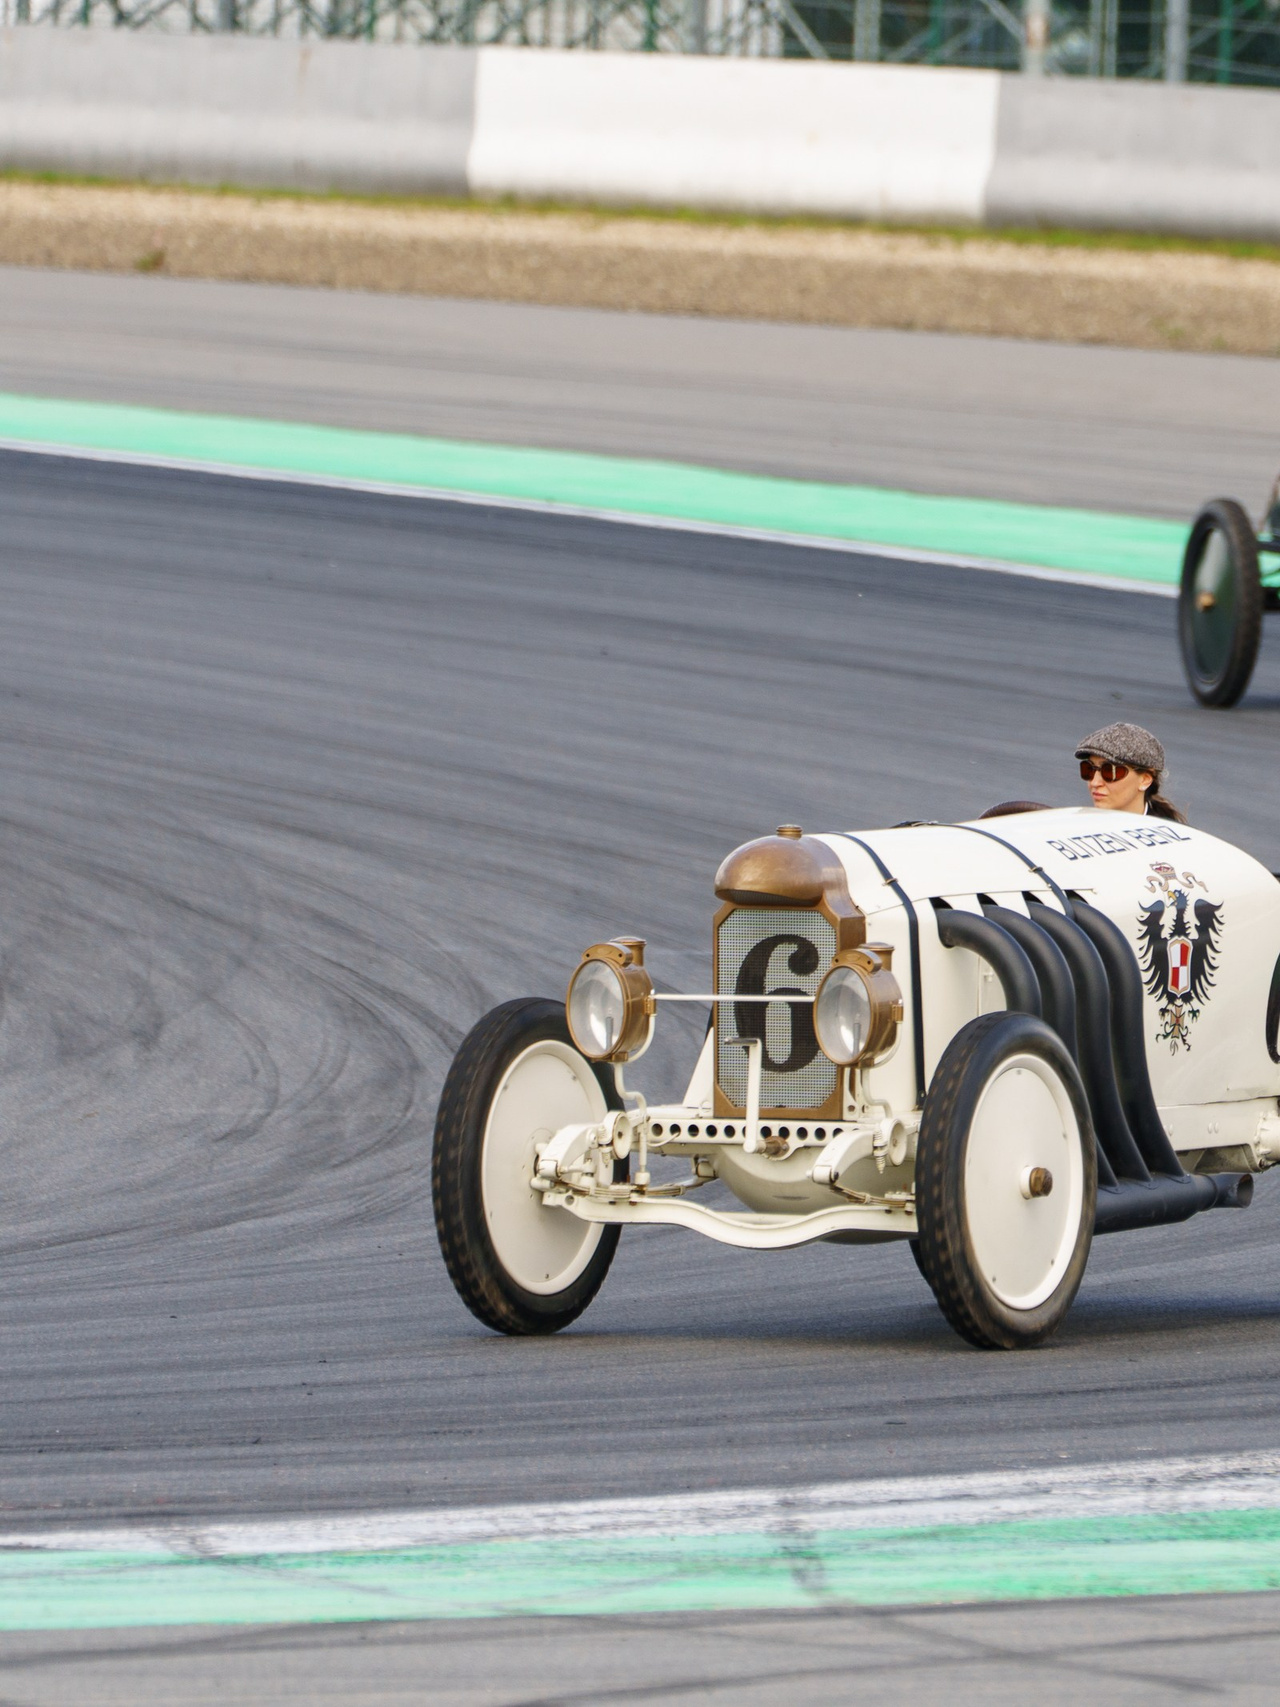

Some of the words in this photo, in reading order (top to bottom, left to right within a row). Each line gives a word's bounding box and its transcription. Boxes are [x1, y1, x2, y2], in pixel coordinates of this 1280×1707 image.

[1046, 832, 1138, 861] BLITZEN
[1123, 825, 1191, 847] BENZ
[734, 934, 822, 1073] 6
